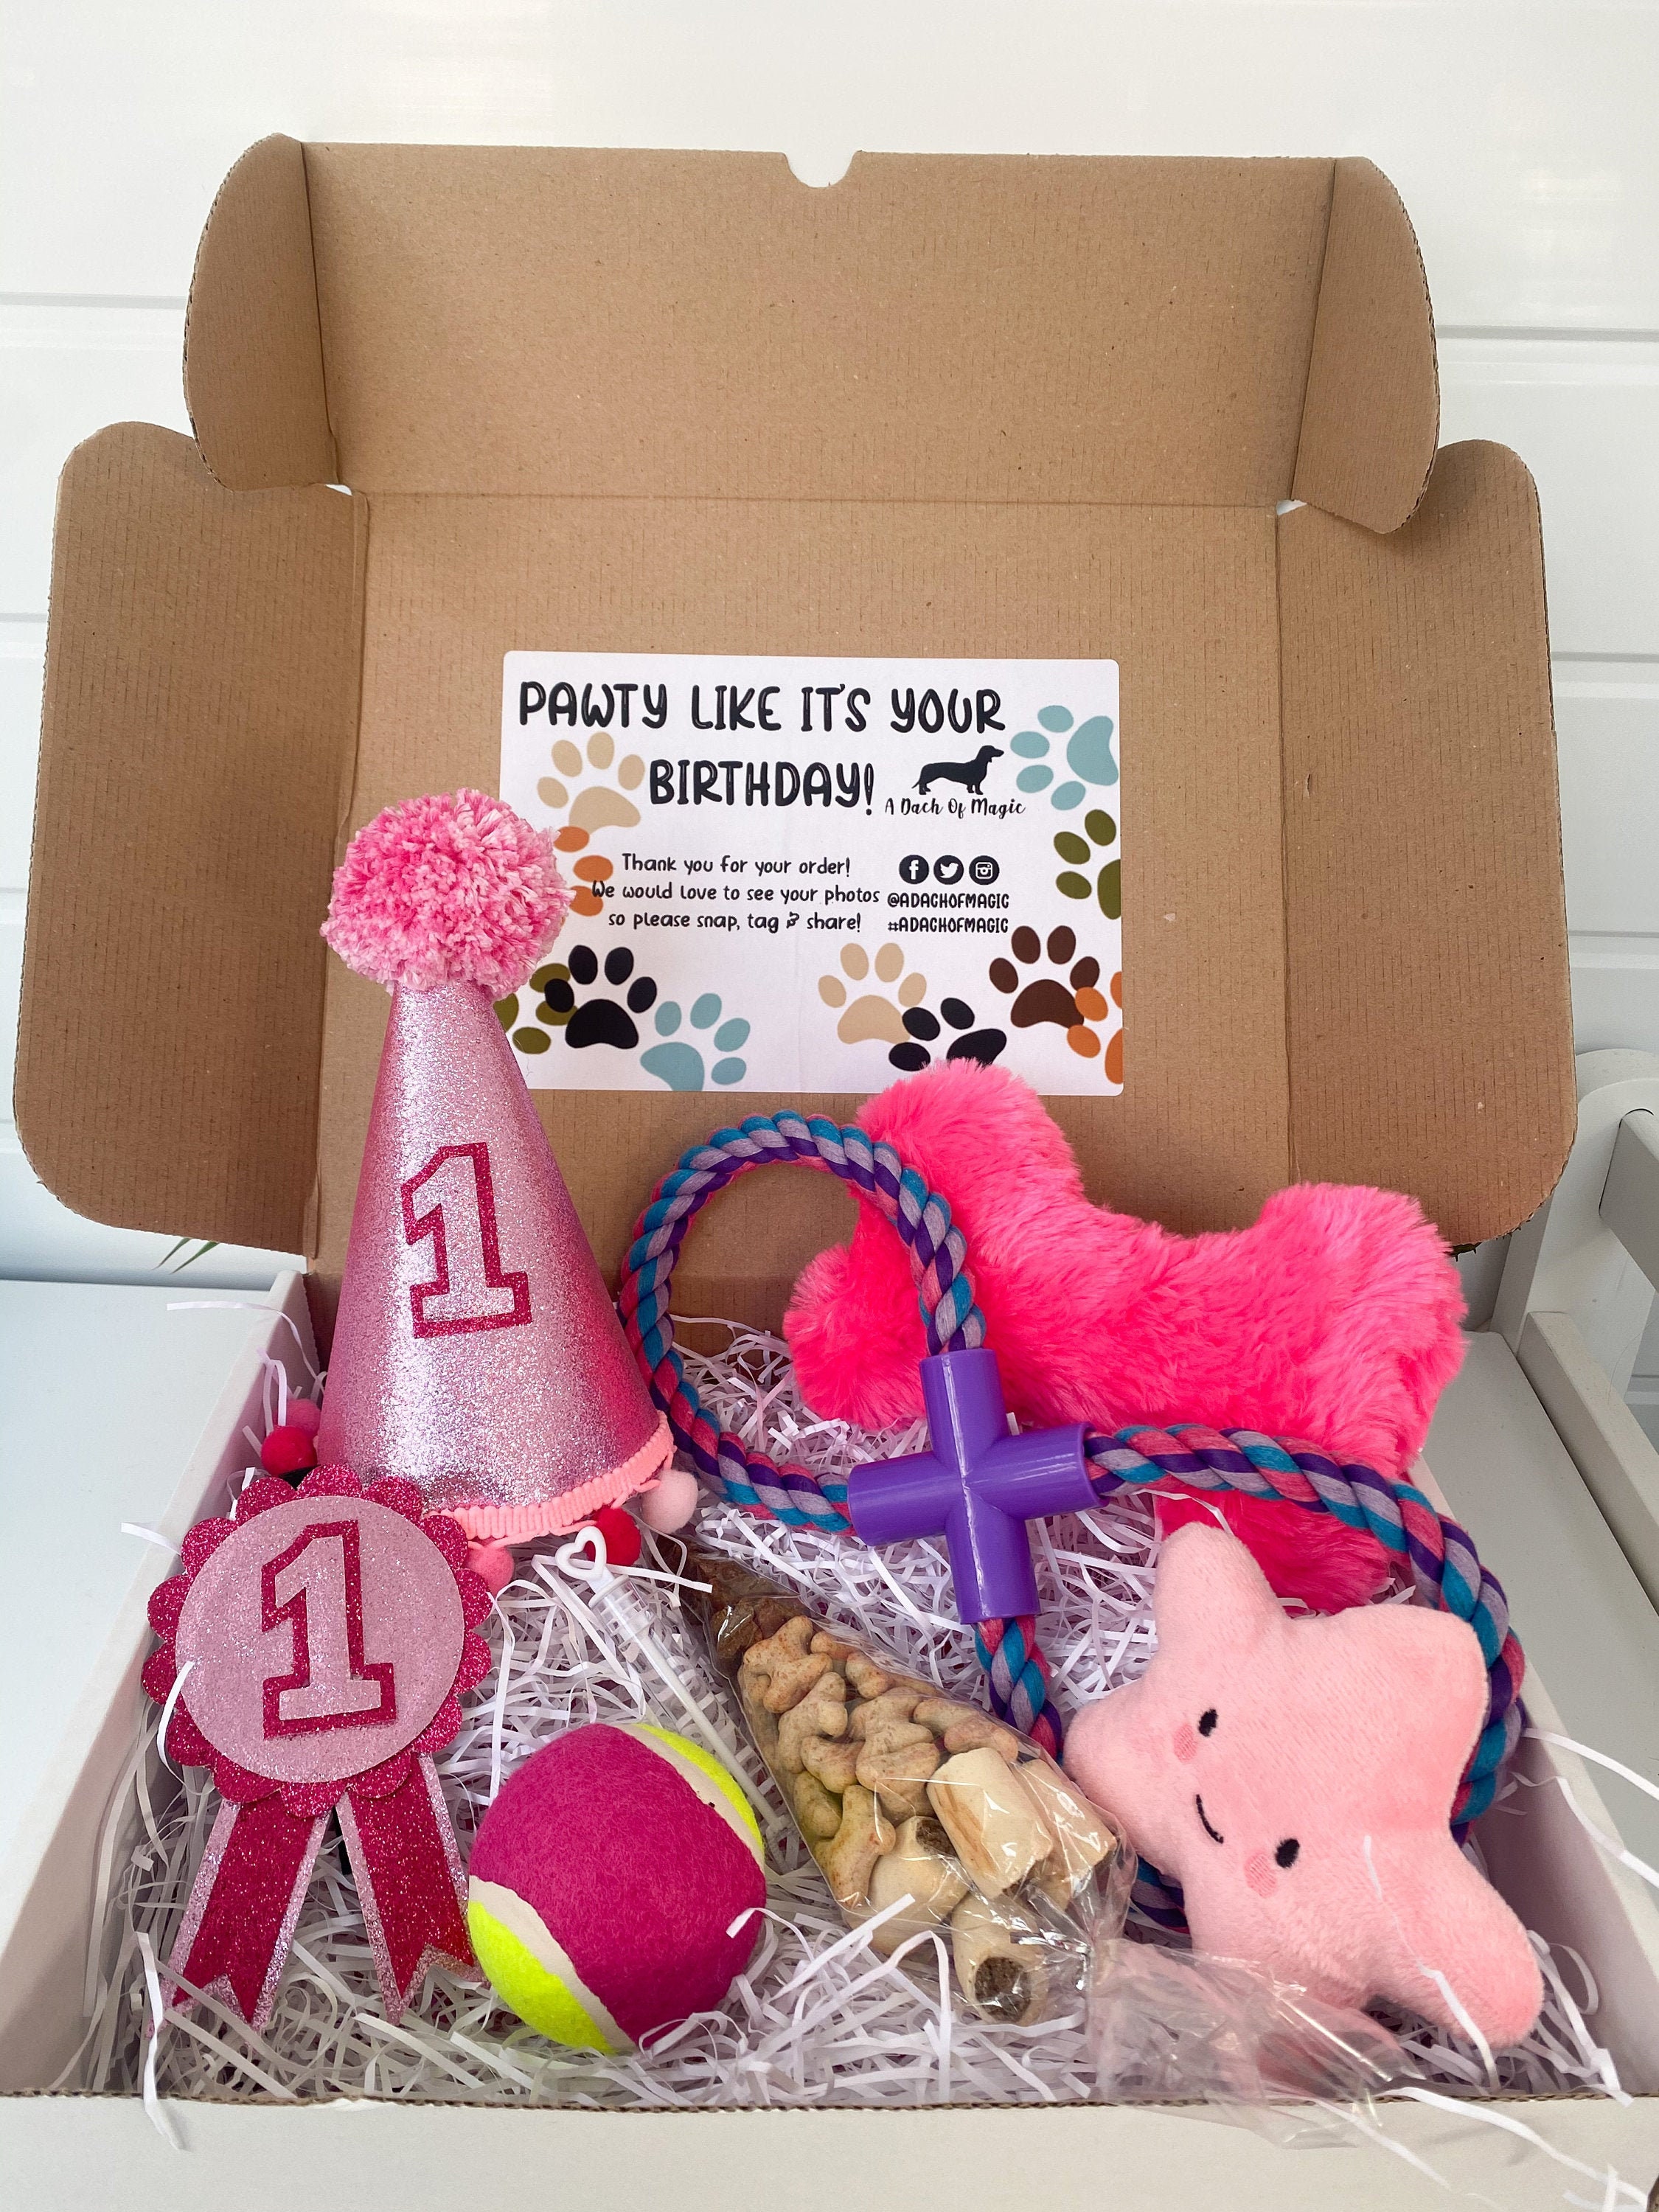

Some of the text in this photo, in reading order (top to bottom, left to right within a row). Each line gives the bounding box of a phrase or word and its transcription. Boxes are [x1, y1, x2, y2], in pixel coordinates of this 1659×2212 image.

[519, 681, 1006, 734] PAWTY LIKE IT'S YOUR
[650, 759, 874, 816] BIRTHDAY!
[885, 797, 1026, 820] A Dach Of Magic
[622, 852, 851, 877] Thank you for your order!
[591, 880, 881, 906] We would love to see your photos
[887, 892, 1009, 909] @ADACHOFMAGIC
[608, 913, 626, 926] so
[633, 912, 691, 931] please
[697, 914, 740, 932] snap,
[747, 913, 779, 934] tag
[807, 911, 862, 933] share!
[888, 917, 1009, 933] #ADACHOFMAGIC
[400, 1142, 533, 1339] 1
[261, 1519, 397, 1740] 1
